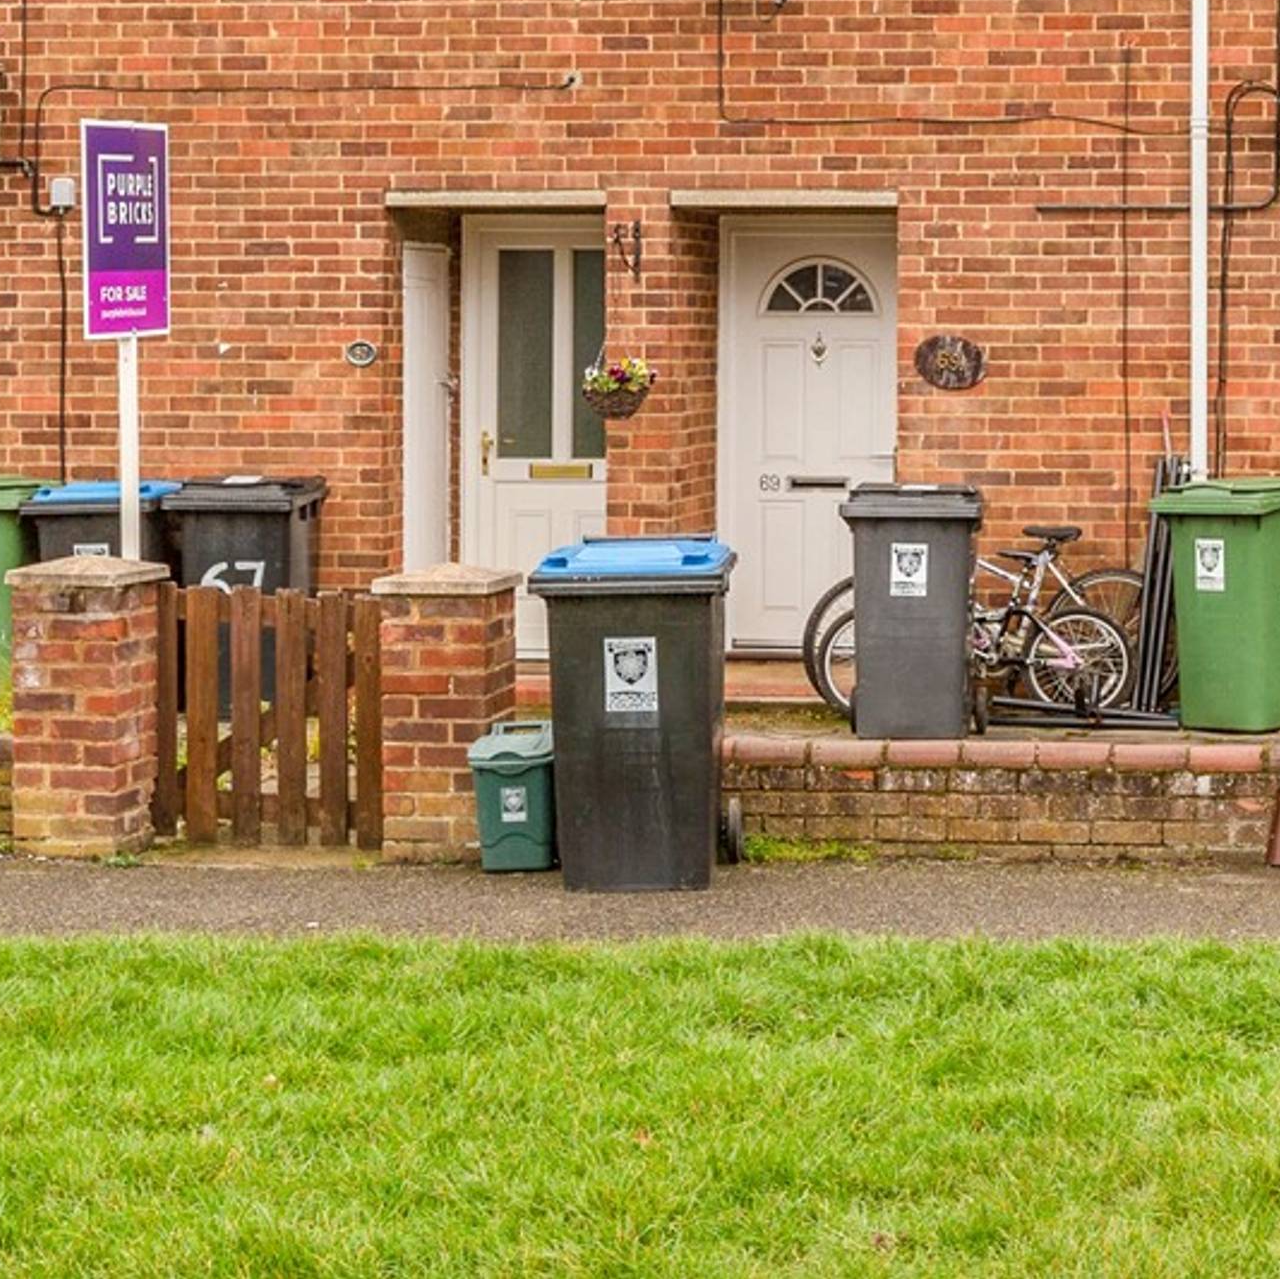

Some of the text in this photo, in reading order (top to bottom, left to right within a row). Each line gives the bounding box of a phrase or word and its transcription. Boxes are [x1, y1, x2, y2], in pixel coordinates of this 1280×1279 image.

[107, 173, 152, 196] PURPLE
[107, 201, 153, 225] BRICKS
[100, 285, 147, 302] FOR SALE
[759, 473, 780, 492] 69
